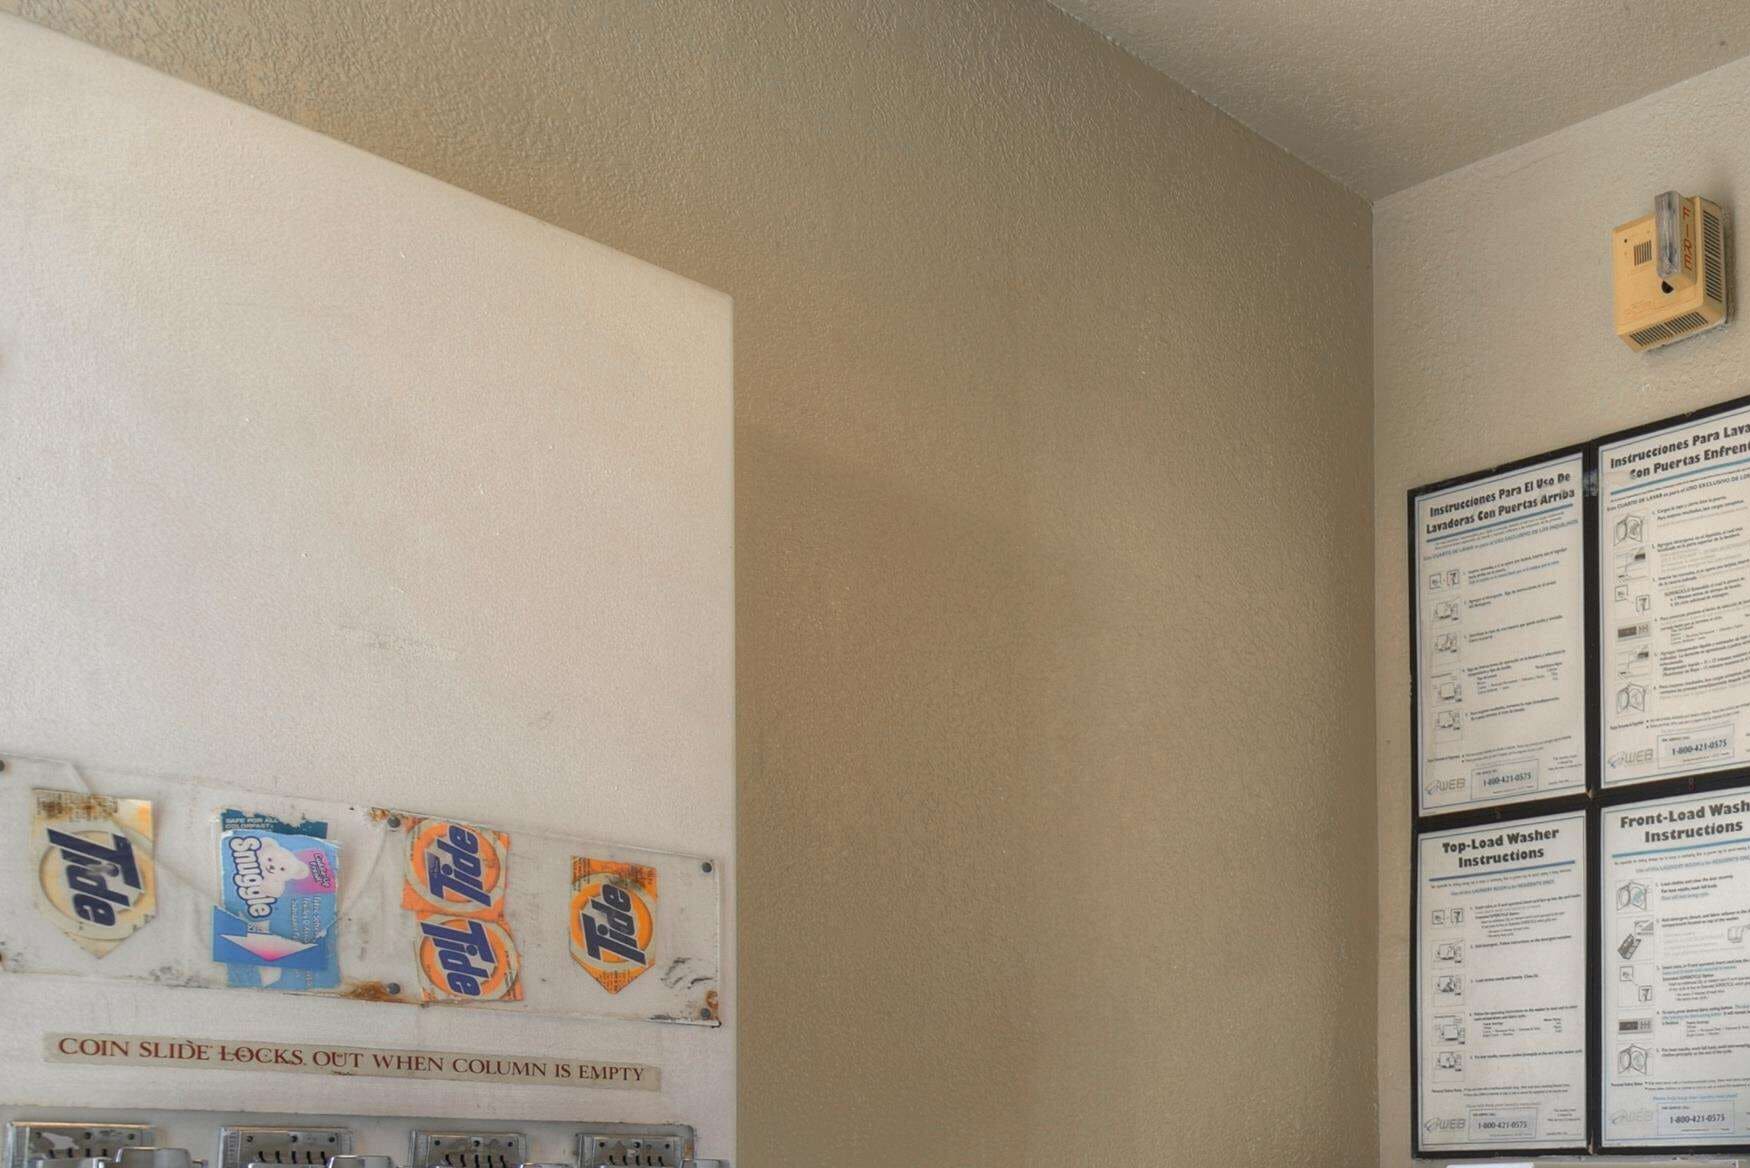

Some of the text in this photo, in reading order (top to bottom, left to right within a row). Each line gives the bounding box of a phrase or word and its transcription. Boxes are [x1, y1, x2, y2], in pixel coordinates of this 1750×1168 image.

[1610, 439, 1688, 468] Instrucciones
[1693, 430, 1720, 447] Para
[1654, 453, 1700, 475] Puertas
[1430, 473, 1570, 517] Instrucciones Para El Uso De
[1427, 489, 1575, 534] Lavadoras Con Puertas Arriba
[1672, 739, 1727, 756] 1-800-421-0575
[1483, 773, 1531, 787] 1-800-421-0575
[1620, 806, 1704, 828] Front-Load
[1644, 821, 1743, 843] Instructions
[1442, 829, 1559, 854] Top-Load Washer
[426, 824, 491, 908] Tide
[1459, 849, 1544, 868] Instructions
[46, 827, 142, 927] Tide
[229, 836, 278, 918] Snuggle
[581, 883, 647, 966] Tide
[421, 919, 497, 997] Tide
[58, 1037, 644, 1082] COIN SLIDE LOCKS OUT WHEN COLUMN IS EMPTY
[1478, 1120, 1527, 1129] 1-800-421-0575
[1670, 1114, 1725, 1124] 1-800-421-0575
